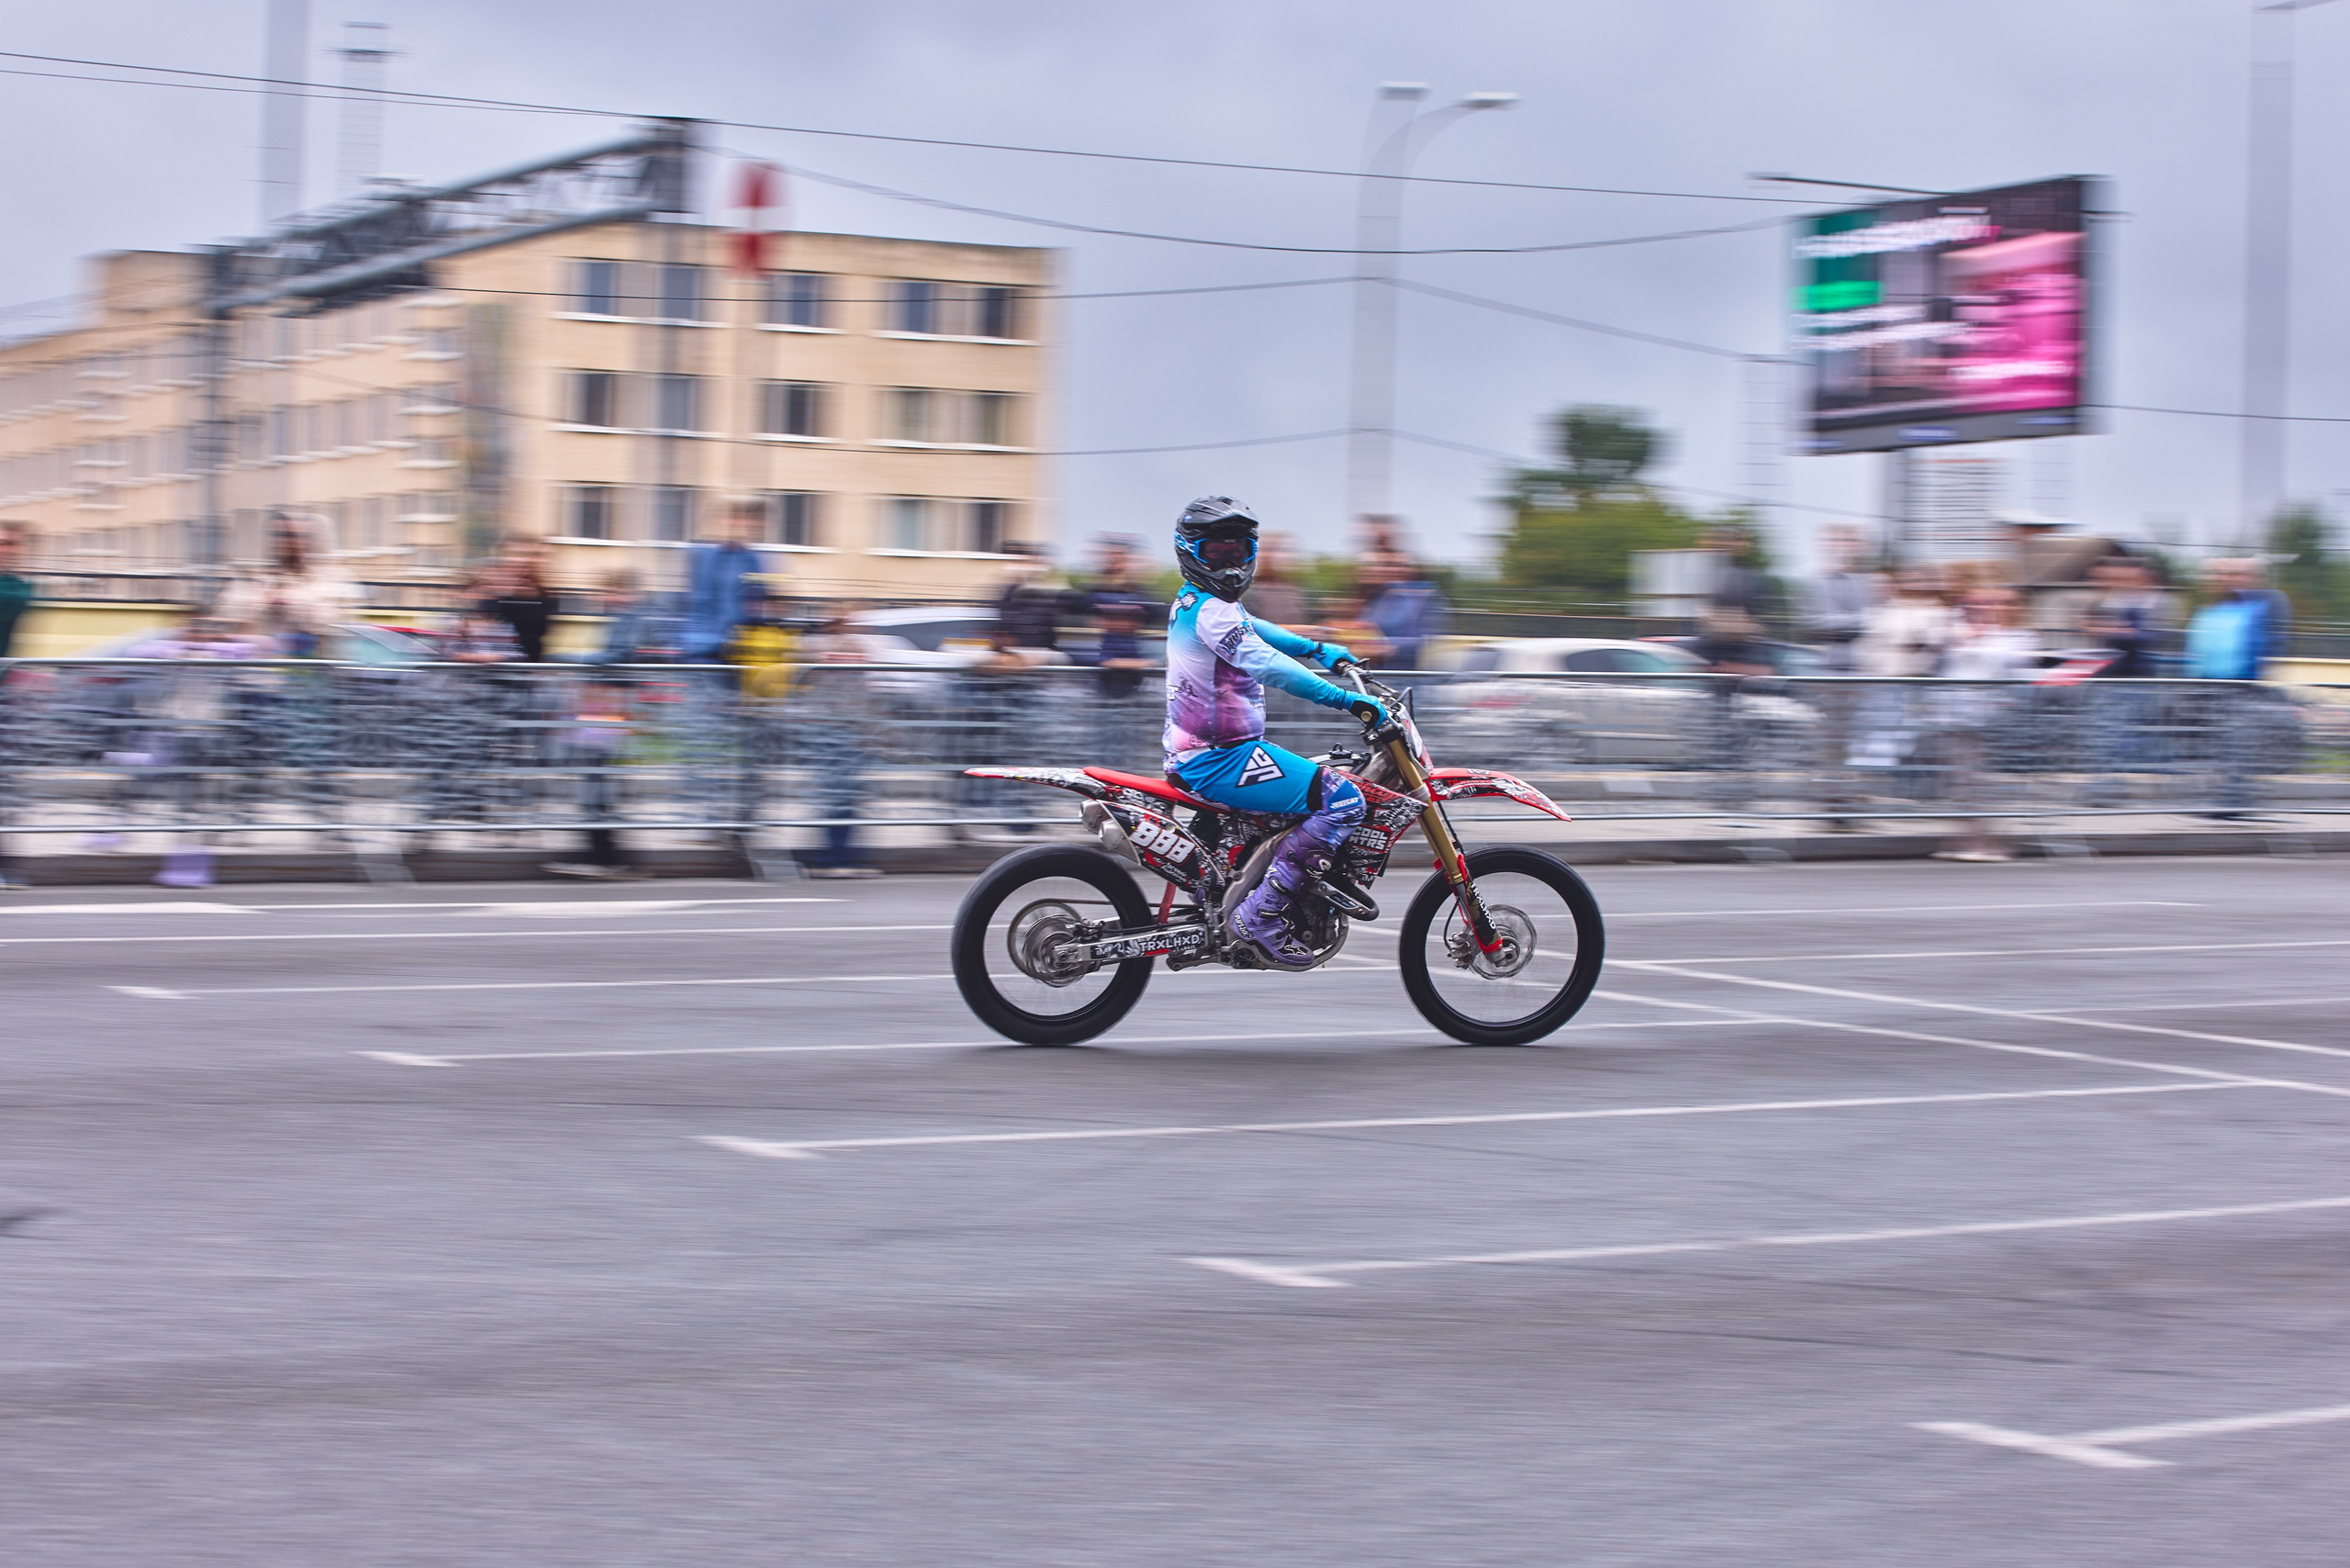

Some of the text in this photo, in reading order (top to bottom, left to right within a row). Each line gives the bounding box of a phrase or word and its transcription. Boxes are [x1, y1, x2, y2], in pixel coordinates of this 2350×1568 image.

[1352, 827, 1389, 840] COOL
[1129, 821, 1196, 864] 888
[1348, 835, 1387, 850] MTRS
[1471, 880, 1496, 930] TRXLHXD
[1139, 935, 1201, 952] TRXLHXD
